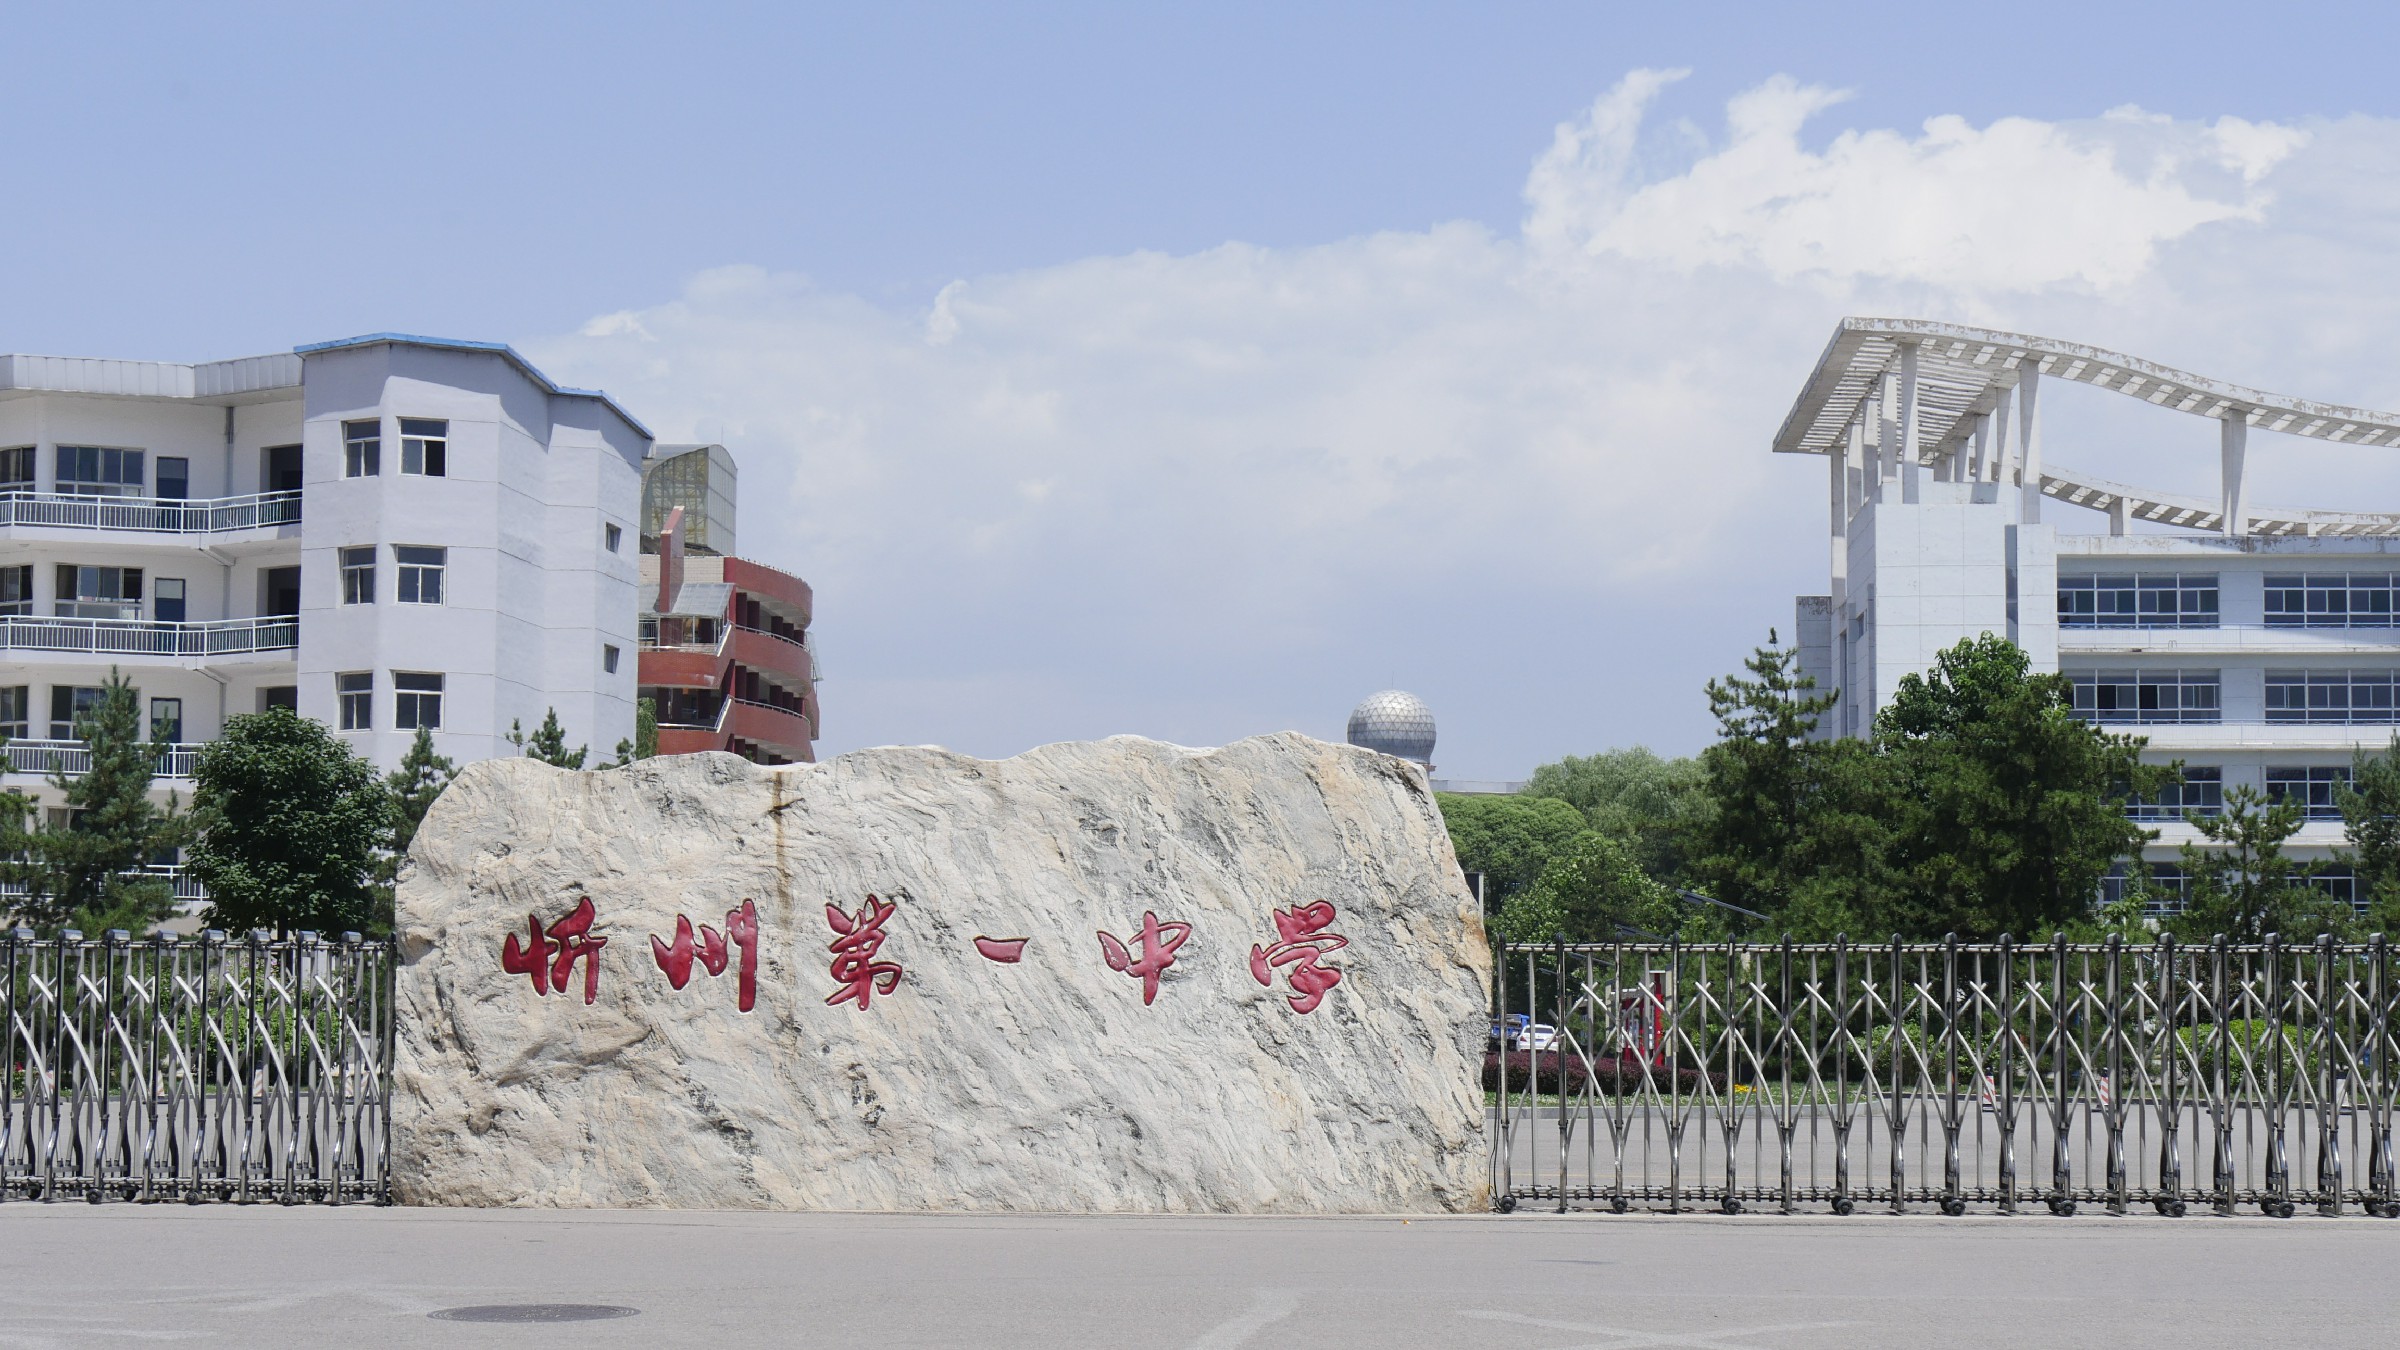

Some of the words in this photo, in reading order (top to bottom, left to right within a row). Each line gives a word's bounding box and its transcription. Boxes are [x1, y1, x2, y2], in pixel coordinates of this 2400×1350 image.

[502, 896, 1348, 1013] 忻州第一中学
